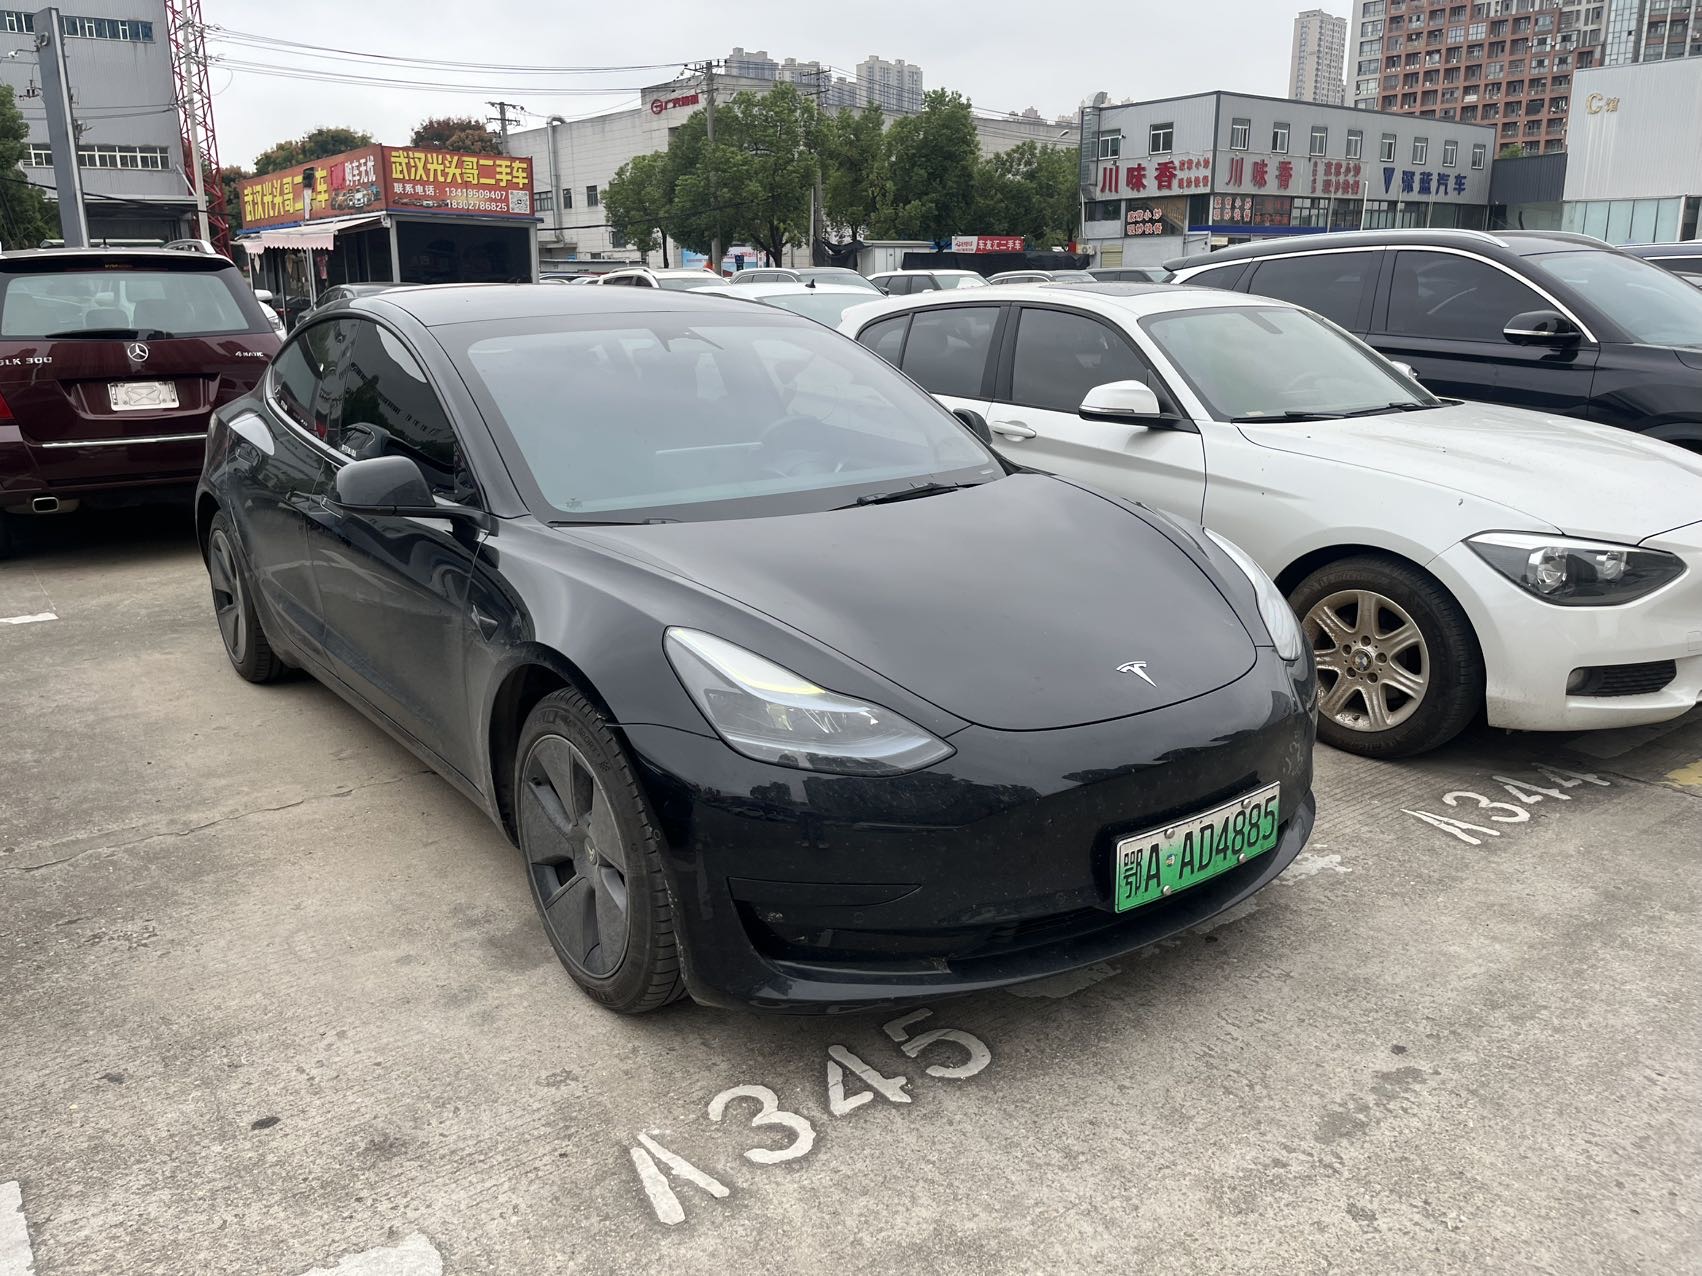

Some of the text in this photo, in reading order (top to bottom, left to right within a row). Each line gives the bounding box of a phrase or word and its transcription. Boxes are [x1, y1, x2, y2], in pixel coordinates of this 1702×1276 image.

[345, 155, 376, 186] 购车无忧
[391, 150, 528, 188] 武汉光头哥二手车
[1100, 160, 1177, 194] 川味香
[1226, 157, 1293, 190] 川味香
[1402, 170, 1467, 195] 深蓝汽车
[244, 167, 328, 221] 武汉光头哥二车
[445, 188, 506, 199] 13419509407
[447, 200, 507, 211] 18302786825
[978, 239, 1021, 250] 车友汇二手车
[25, 357, 53, 365] 300
[630, 1008, 991, 1225] A345
